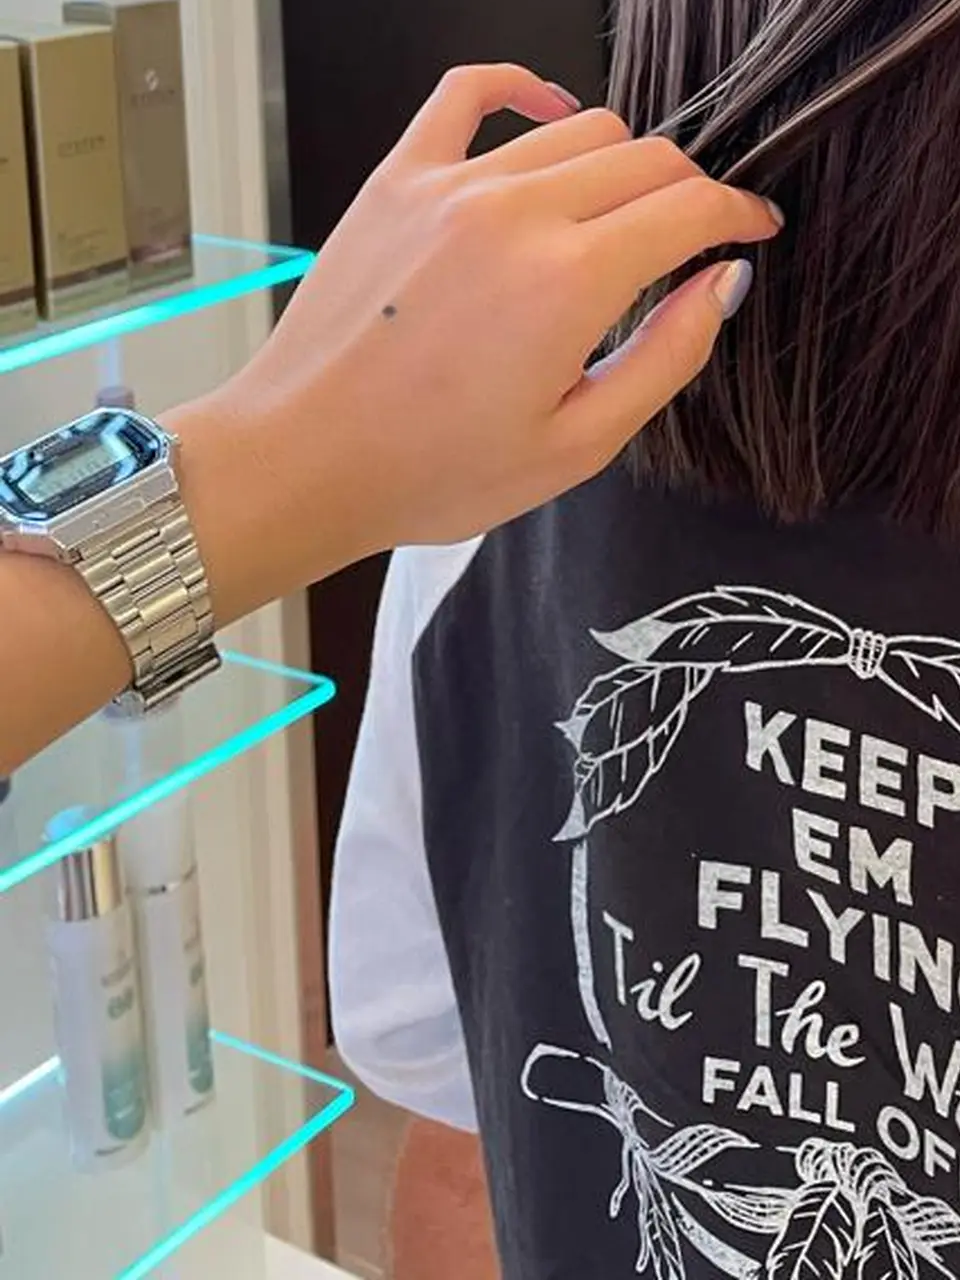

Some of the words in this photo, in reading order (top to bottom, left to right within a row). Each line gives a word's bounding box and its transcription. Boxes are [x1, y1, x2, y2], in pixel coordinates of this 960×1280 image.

[791, 807, 914, 906] EM
[602, 910, 702, 1031] Til
[737, 953, 866, 1069] The
[702, 1056, 856, 1133] FALL
